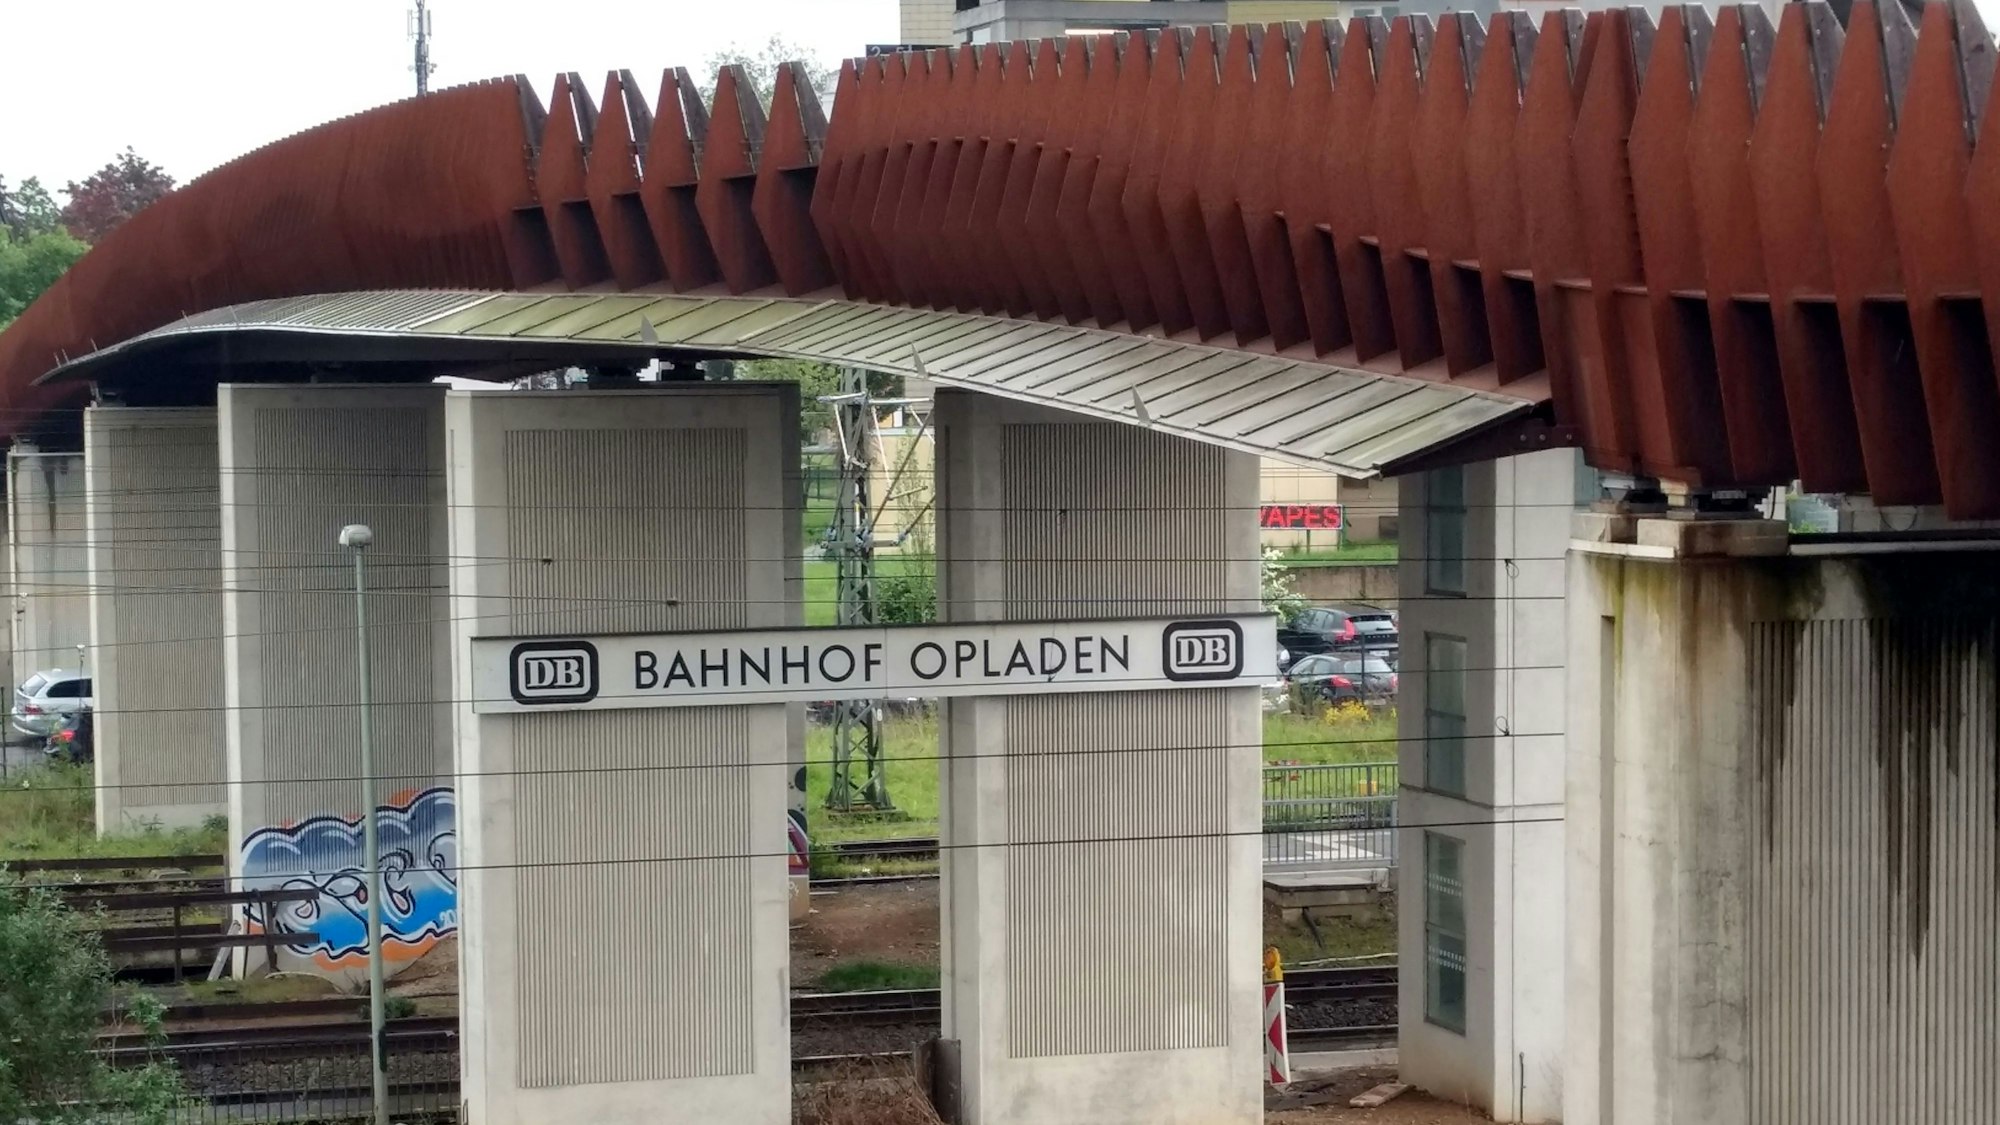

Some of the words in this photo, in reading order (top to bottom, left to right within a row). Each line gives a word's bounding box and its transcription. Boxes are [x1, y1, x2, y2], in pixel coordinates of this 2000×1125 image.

[526, 658, 581, 687] DB
[634, 643, 882, 690] BAHNHOF
[910, 634, 1129, 680] OPLADEN
[1177, 637, 1227, 665] DB
